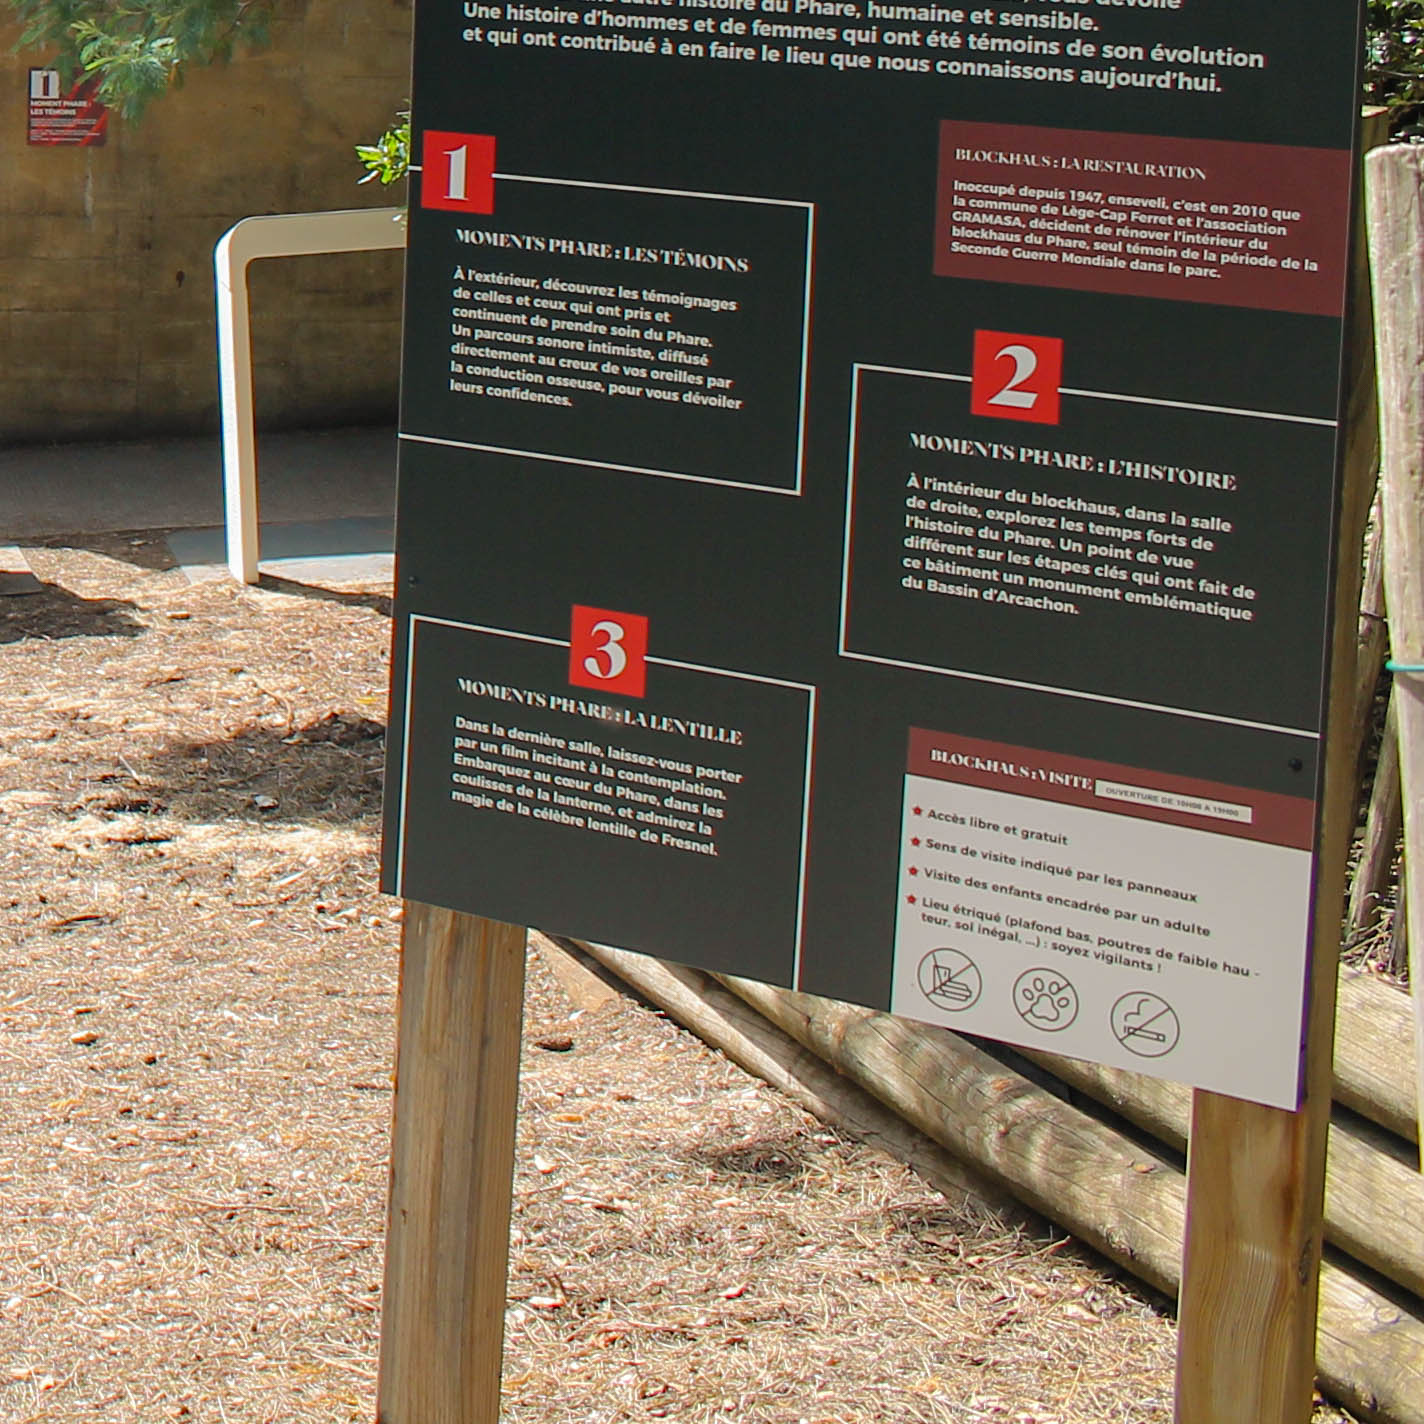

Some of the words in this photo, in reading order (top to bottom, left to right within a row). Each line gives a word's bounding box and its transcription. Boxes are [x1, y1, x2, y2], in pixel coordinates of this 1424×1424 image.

[464, 2, 502, 19] Une
[506, 3, 579, 24] histoire
[693, 17, 716, 33] et
[720, 17, 747, 35] de
[751, 18, 837, 41] femmes
[842, 25, 878, 46] qui
[883, 30, 921, 47] ont
[926, 29, 962, 49] été
[967, 32, 1060, 55] témoins
[1066, 38, 1096, 58] de
[1101, 44, 1144, 61] son
[1150, 43, 1264, 68] évolution
[867, 0, 964, 23] humaine
[970, 8, 994, 25] et
[999, 10, 1099, 31] sensible.
[463, 26, 483, 42] et
[486, 27, 518, 47] qui
[522, 31, 557, 47] ont
[560, 34, 656, 54] contribué
[660, 37, 673, 55] à
[678, 43, 704, 57] en
[709, 41, 756, 61] faire
[761, 44, 781, 62] le
[786, 45, 825, 66] lieu
[830, 53, 872, 71] que
[877, 56, 931, 73] nous
[935, 59, 1074, 82] connaissons
[443, 145, 468, 201] 1
[954, 179, 1016, 198] Inoccupé
[1018, 185, 1066, 201] depuis
[1069, 189, 1105, 205] 1947,
[1108, 195, 1170, 210] enseveli,
[1209, 204, 1229, 215] en
[1232, 204, 1268, 218] 2010
[1271, 210, 1301, 222] que
[456, 228, 546, 251] MOMENTS
[549, 238, 612, 259] PHARE
[624, 246, 658, 263] LES
[660, 248, 749, 273] TÉMOINS
[453, 265, 465, 281] À
[542, 277, 616, 298] découvrez
[618, 285, 639, 300] les
[641, 289, 737, 312] témoignages
[451, 323, 472, 337] Un
[474, 328, 534, 345] parcours
[536, 336, 585, 351] sonore
[587, 339, 655, 361] intimiste,
[658, 348, 709, 367] diffusé
[450, 378, 484, 395] leurs
[486, 386, 573, 407] confidences.
[987, 345, 1038, 409] 2
[910, 433, 1015, 460] MOMENTS
[1019, 447, 1094, 472] PHARE
[906, 472, 920, 489] À
[1004, 489, 1027, 504] du
[1031, 491, 1121, 518] blockhaus,
[1124, 505, 1167, 523] dans
[1171, 511, 1187, 527] la
[1190, 516, 1232, 533] salle
[902, 575, 923, 590] du
[927, 578, 979, 599] Bassin
[902, 557, 922, 569] ce
[925, 557, 1000, 582] bâtiment
[1002, 572, 1024, 585] un
[1028, 576, 1121, 601] monument
[1124, 591, 1253, 621] emblématique
[584, 621, 627, 679] 3
[458, 678, 547, 707] MOMENTS
[549, 695, 613, 721] PHARE
[624, 710, 648, 728] LA
[650, 715, 742, 746] LENTILLE
[455, 716, 490, 734] Dans
[492, 723, 505, 737] la
[507, 727, 566, 749] dernière
[568, 741, 604, 758] salle,
[607, 745, 693, 774] laissez-vous
[695, 765, 743, 784] porter
[1105, 787, 1159, 803] OUVERTURE
[1160, 796, 1174, 805] DE
[927, 809, 966, 825] Accès
[969, 816, 1000, 832] libre
[1003, 825, 1017, 836] et
[1020, 829, 1068, 846] gratuit
[926, 838, 957, 854] Sens
[960, 845, 978, 858] de
[981, 850, 1017, 866] visite
[1020, 857, 1073, 877] indiqué
[1076, 871, 1100, 882] par
[1103, 873, 1123, 888] les
[1127, 881, 1197, 903] panneaux
[924, 867, 961, 885] Visite
[964, 877, 988, 890] des
[991, 884, 1043, 902] enfants
[1046, 895, 1110, 916] encadrée
[1114, 909, 1138, 921] par
[1141, 915, 1160, 927] un
[1163, 919, 1211, 937] adulte
